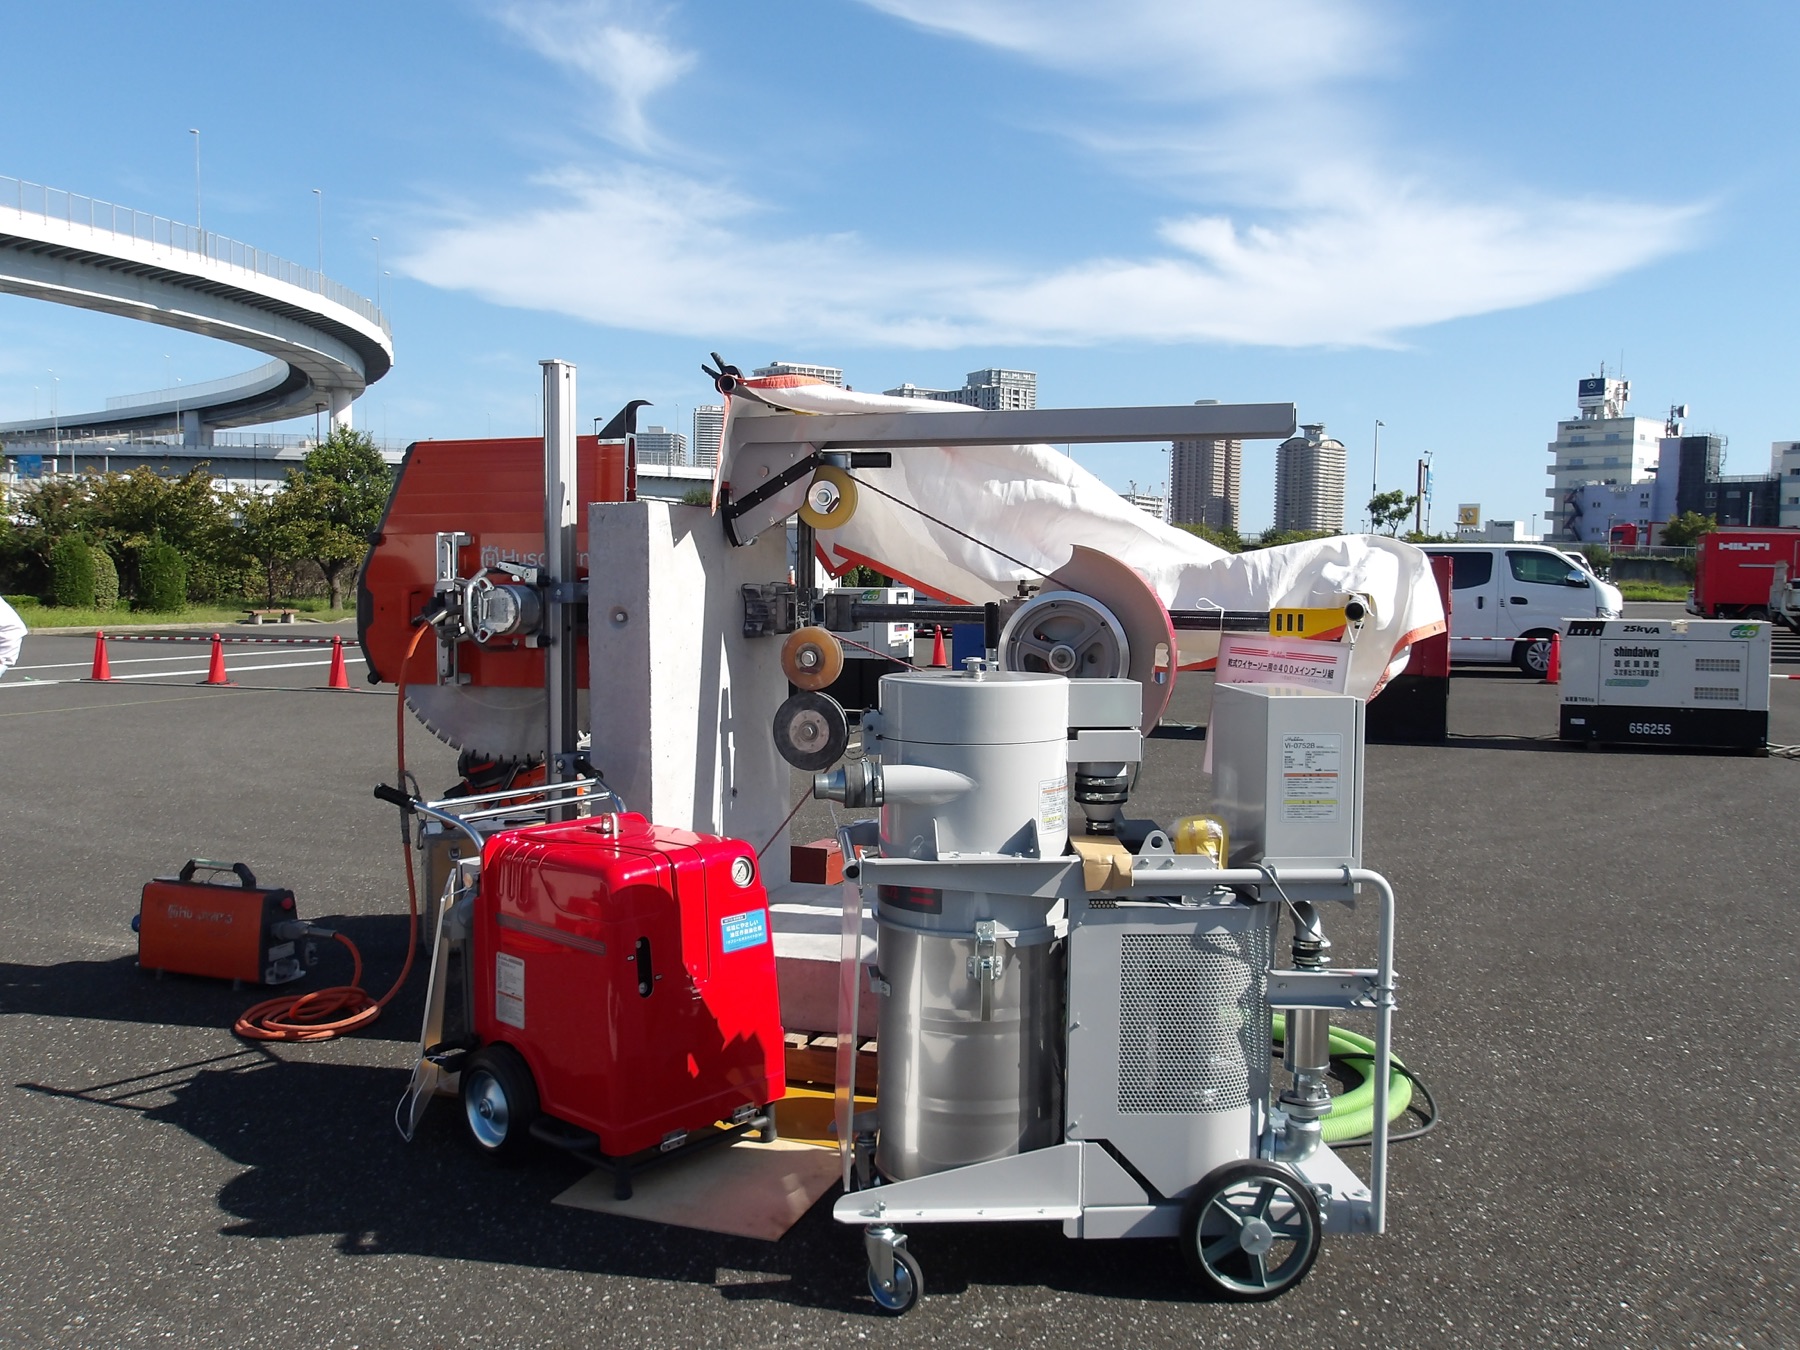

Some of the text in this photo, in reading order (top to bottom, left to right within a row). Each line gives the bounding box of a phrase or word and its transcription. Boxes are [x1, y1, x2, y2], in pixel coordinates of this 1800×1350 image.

[1718, 542, 1770, 551] HILTI
[1622, 625, 1660, 635] 25kVA
[1613, 646, 1659, 657] shindaiwa
[1628, 722, 1672, 735] 656255
